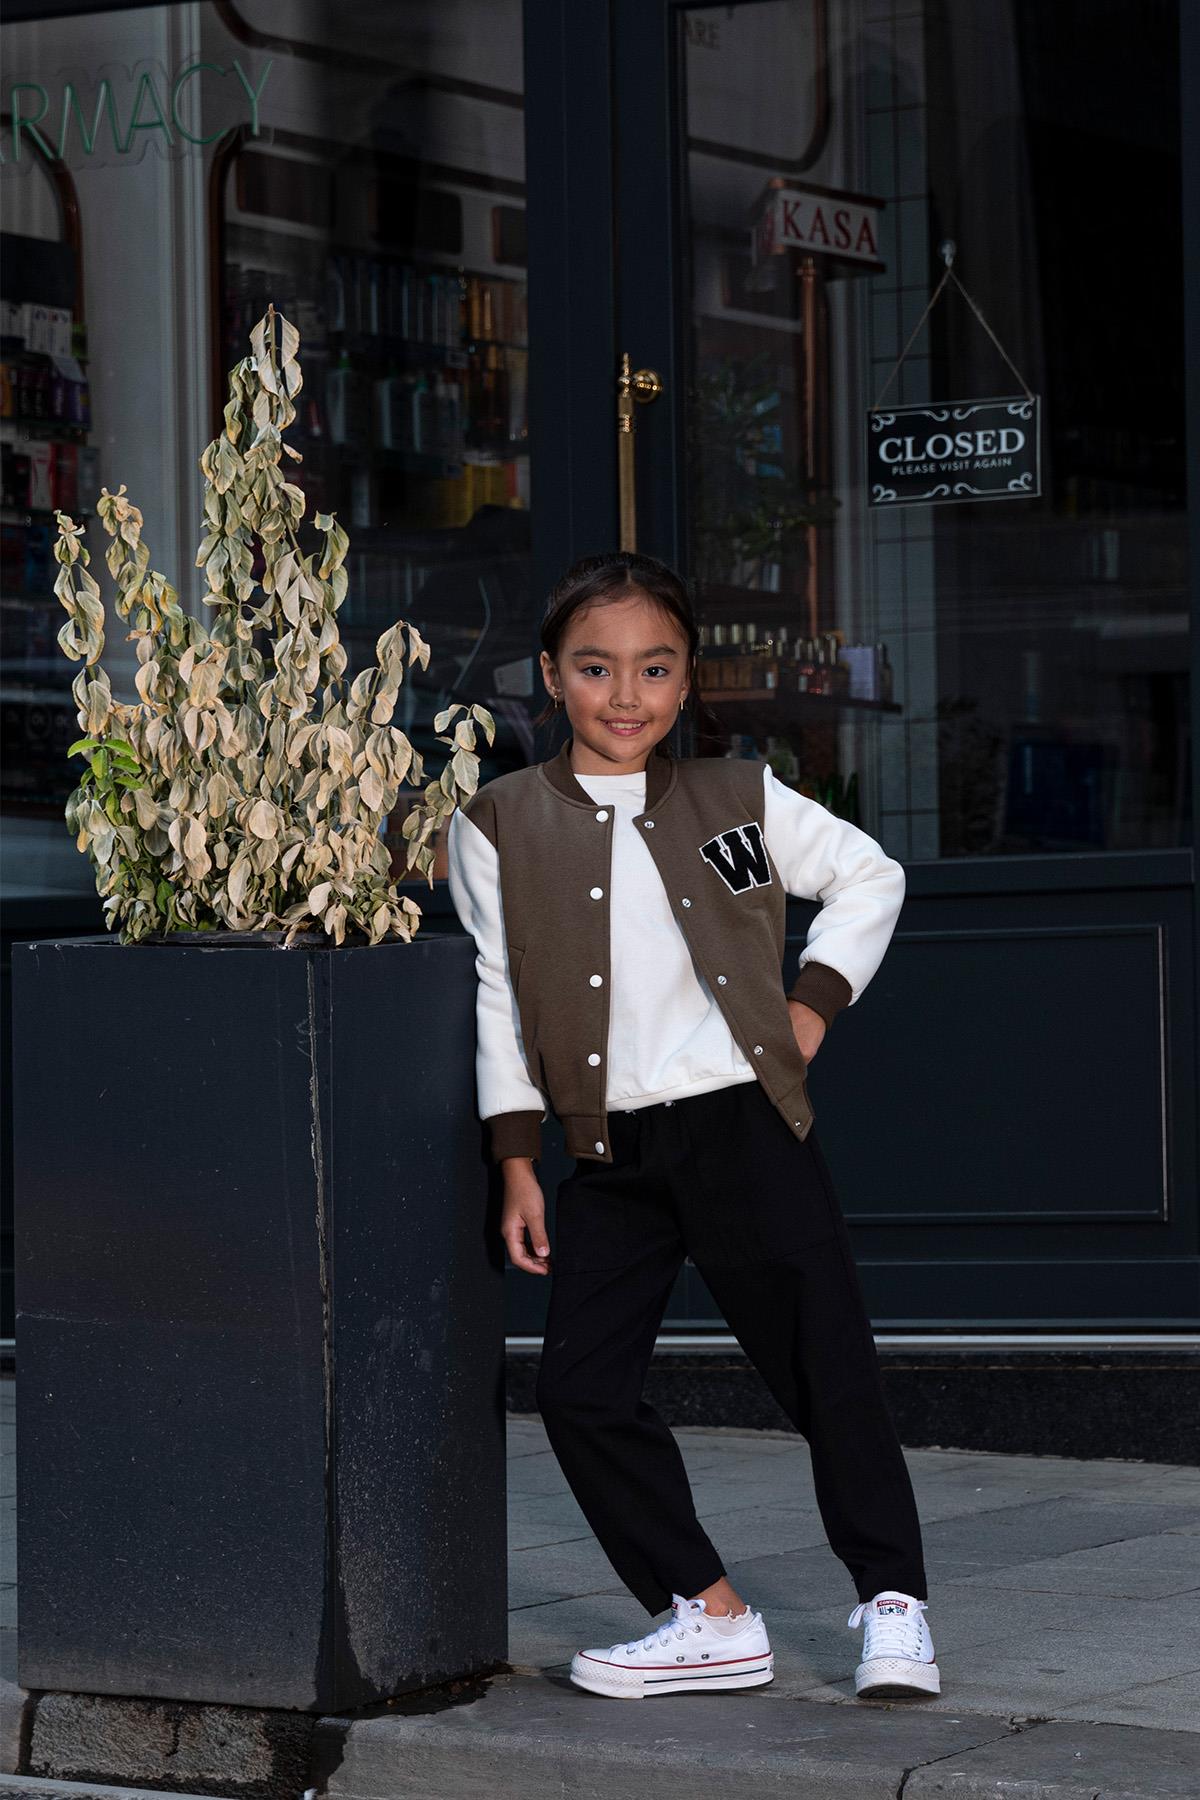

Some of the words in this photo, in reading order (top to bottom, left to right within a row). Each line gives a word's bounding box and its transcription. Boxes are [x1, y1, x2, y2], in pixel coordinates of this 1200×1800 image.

[0, 57, 274, 164] RMACY
[782, 200, 877, 255] KASA
[878, 428, 1025, 464] CLOSED
[891, 463, 936, 477] PLEASE
[939, 460, 970, 473] VISIT
[973, 456, 1013, 470] AGAIN
[698, 821, 773, 896] W
